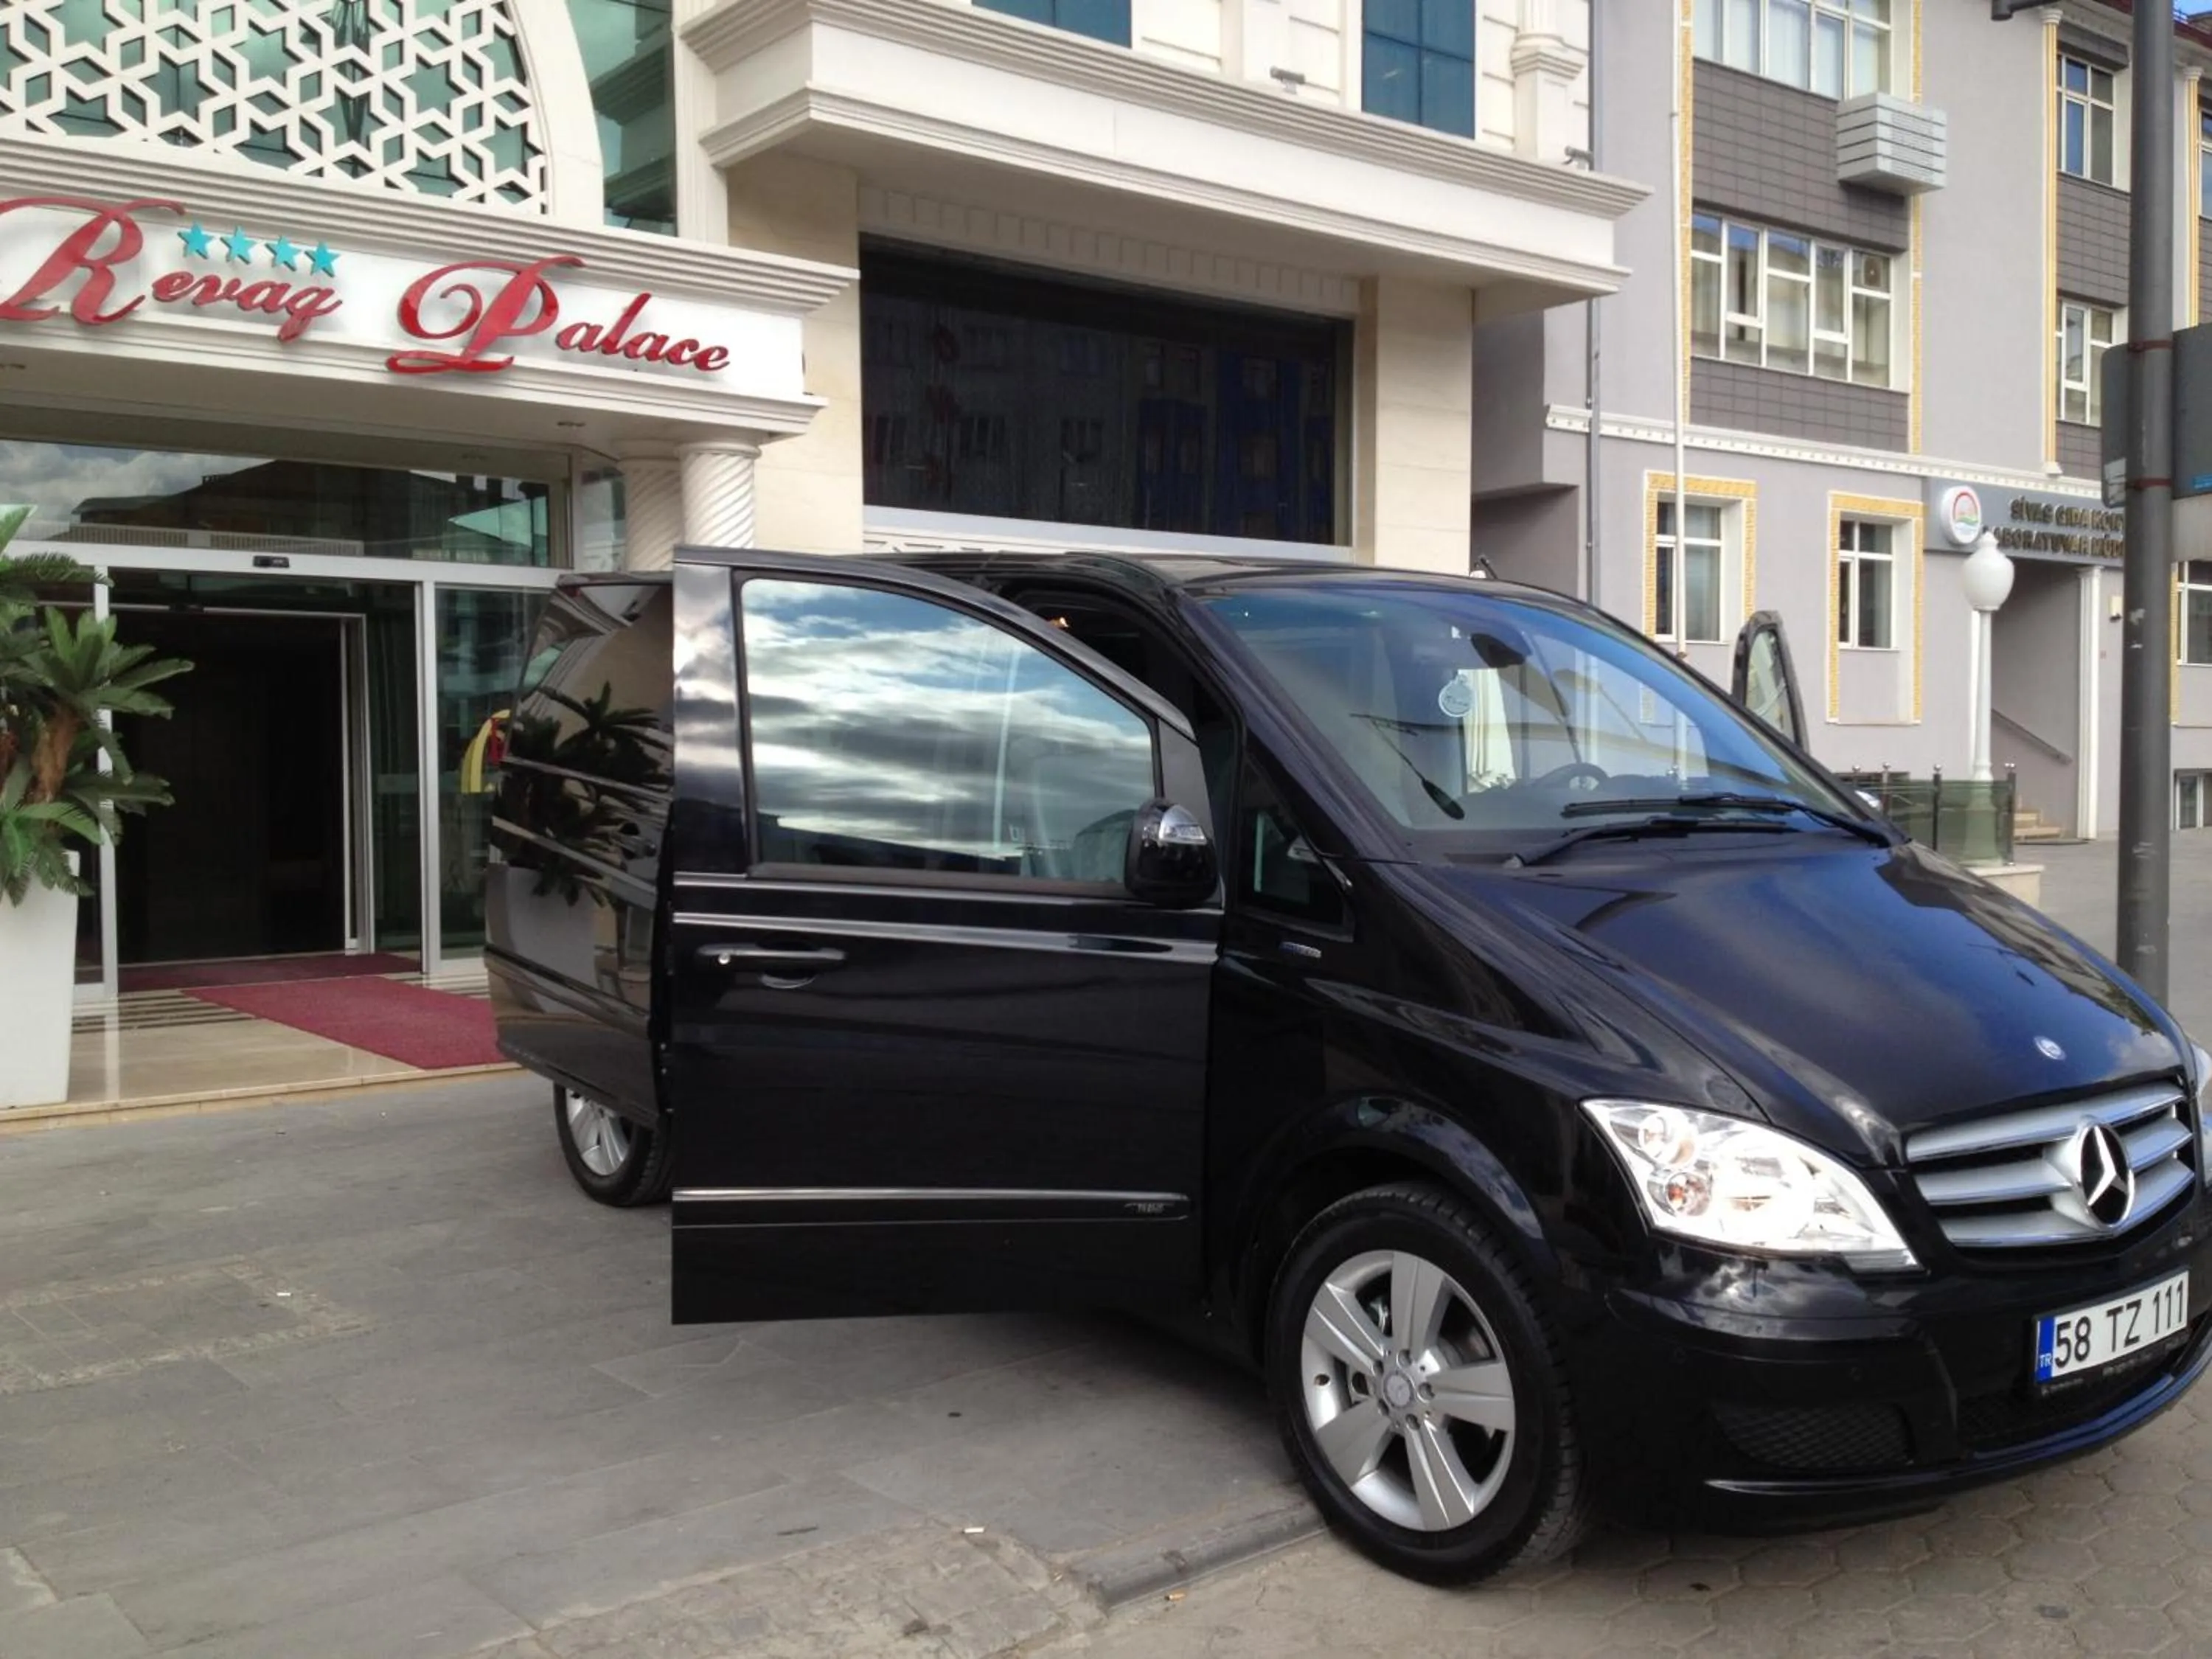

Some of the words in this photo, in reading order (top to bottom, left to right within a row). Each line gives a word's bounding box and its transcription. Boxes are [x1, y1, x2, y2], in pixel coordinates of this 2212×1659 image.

[387, 255, 730, 373] Palace
[2039, 1353, 2053, 1368] TR
[2054, 1315, 2092, 1369] 58
[2106, 1298, 2143, 1353] TZ
[2153, 1279, 2184, 1335] 111
